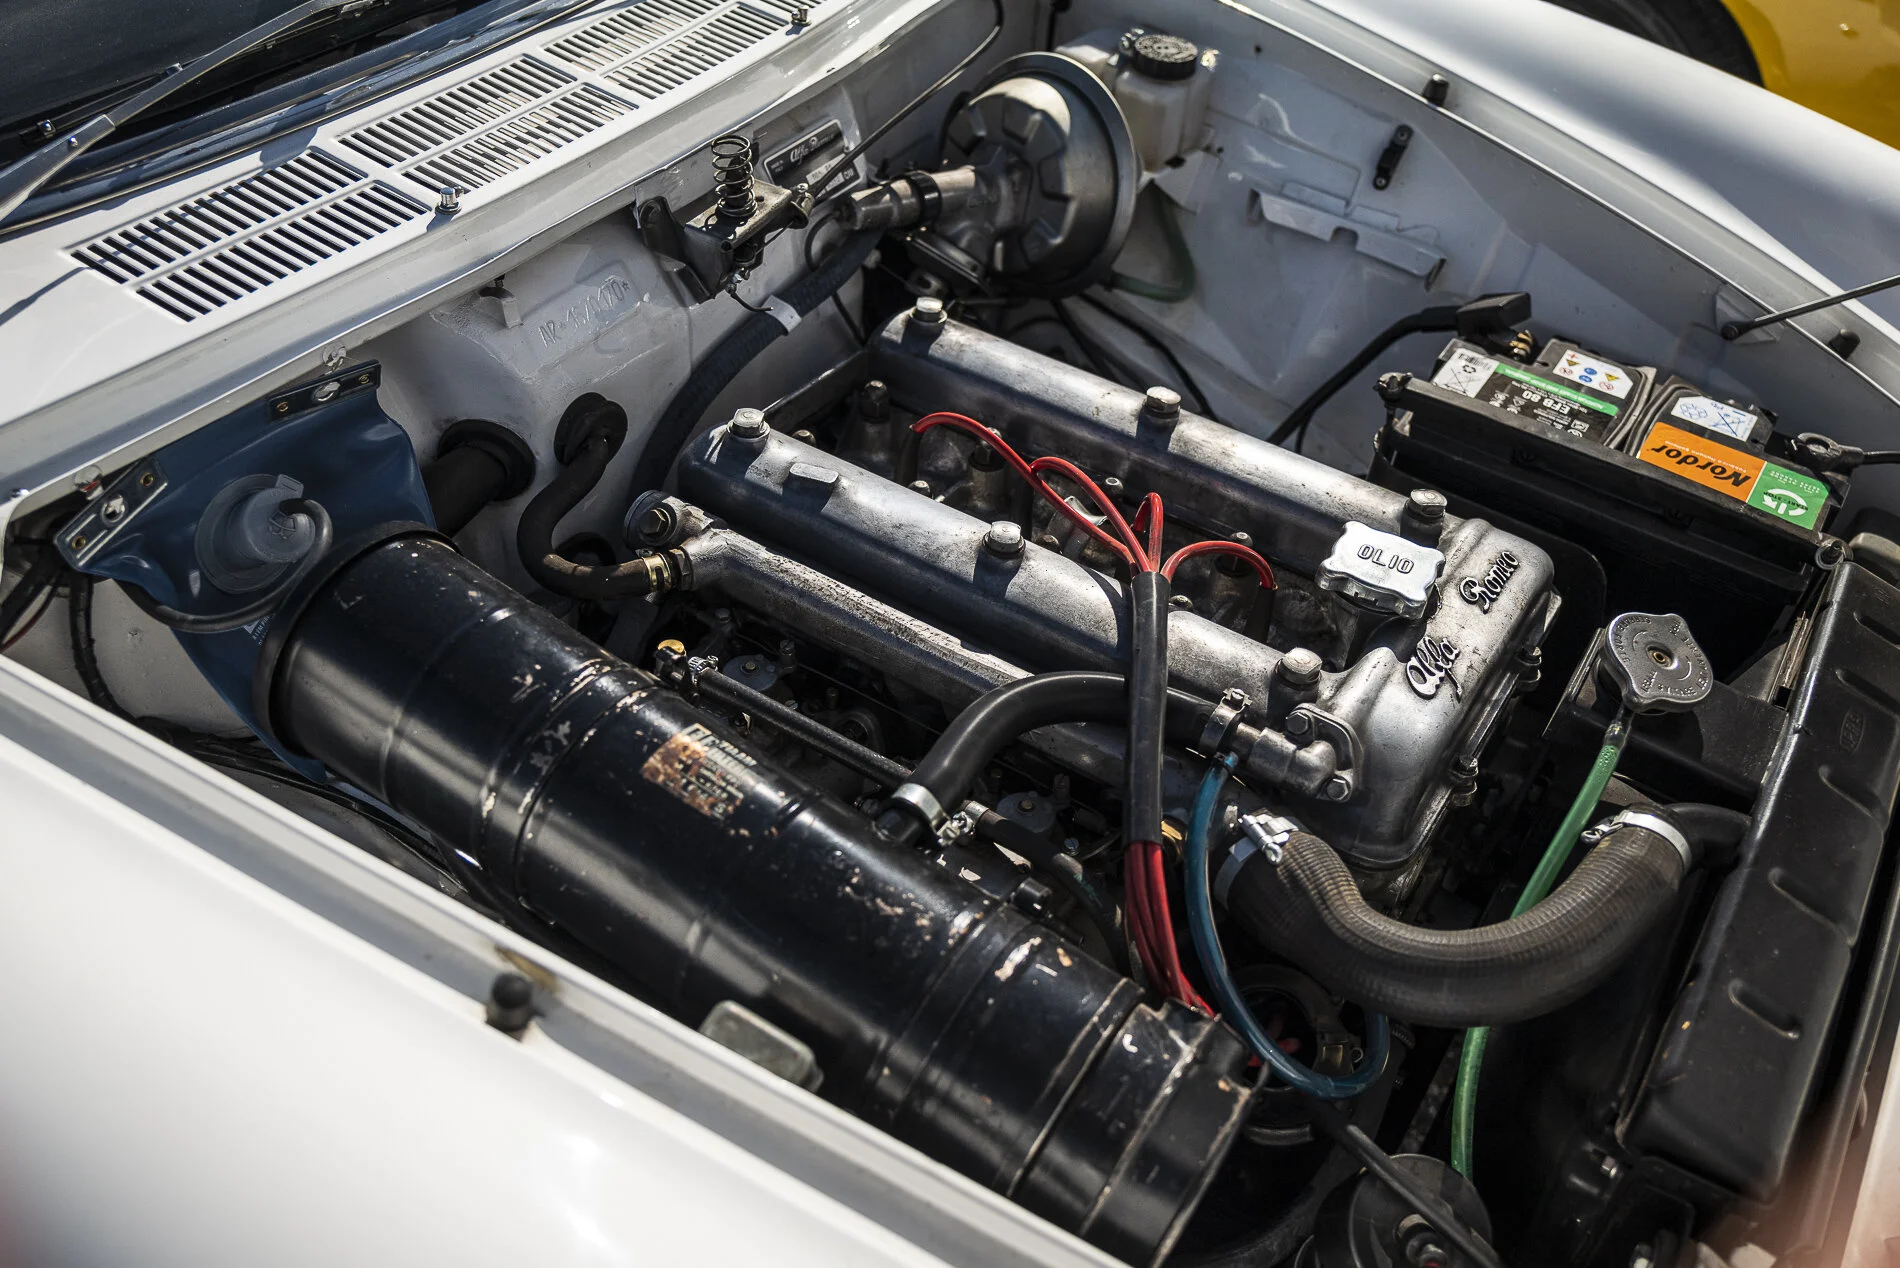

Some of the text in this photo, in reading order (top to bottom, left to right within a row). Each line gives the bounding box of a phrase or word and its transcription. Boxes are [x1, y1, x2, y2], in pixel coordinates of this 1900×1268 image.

[1522, 390, 1542, 403] 80
[1542, 398, 1571, 415] EFB
[1650, 445, 1752, 488] Nordor
[1357, 544, 1415, 574] OLIO
[1406, 550, 1519, 703] Alfa Romeo
